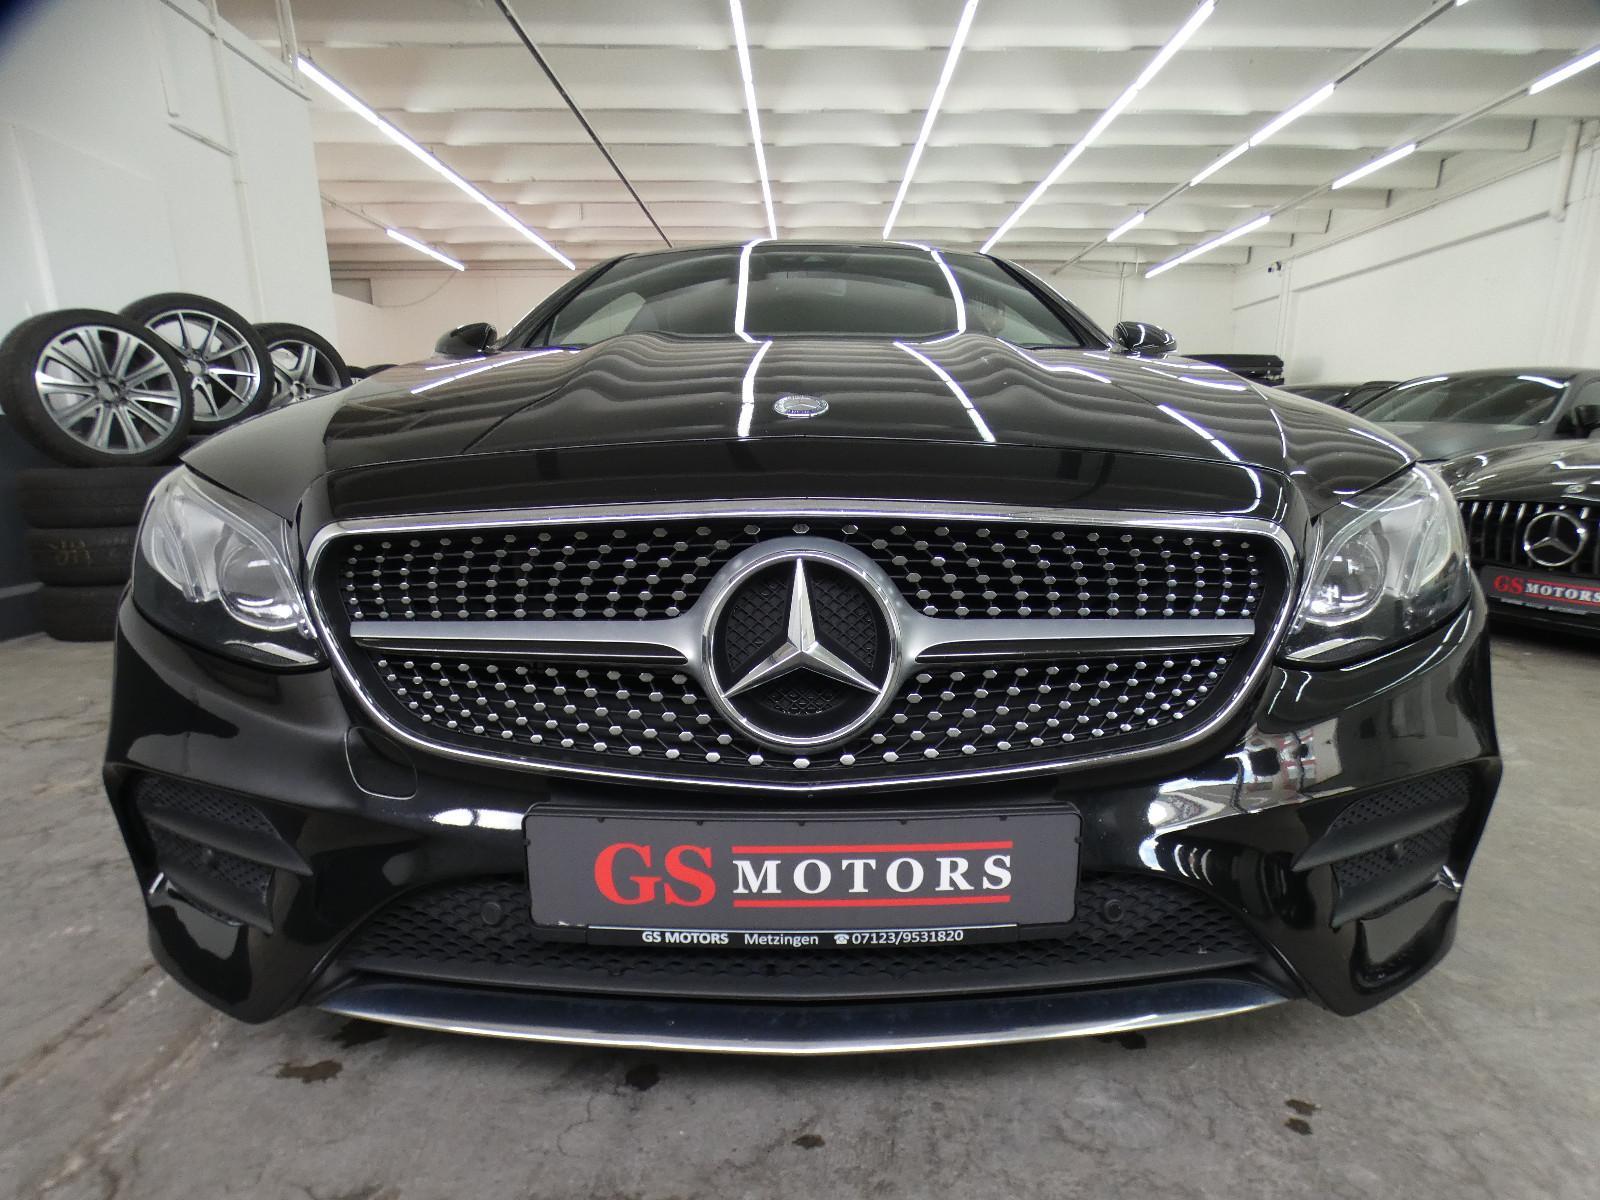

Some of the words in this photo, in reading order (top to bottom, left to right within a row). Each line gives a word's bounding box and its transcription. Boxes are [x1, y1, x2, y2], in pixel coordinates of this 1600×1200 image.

[1493, 575, 1524, 594] GS
[1525, 583, 1600, 603] MOTORS
[594, 842, 716, 907] GS
[732, 855, 1013, 895] MOTORS
[641, 931, 662, 943] GS
[664, 932, 729, 945] MOTORS
[744, 933, 819, 948] Metzingen
[851, 929, 964, 946] 07123/9531820
